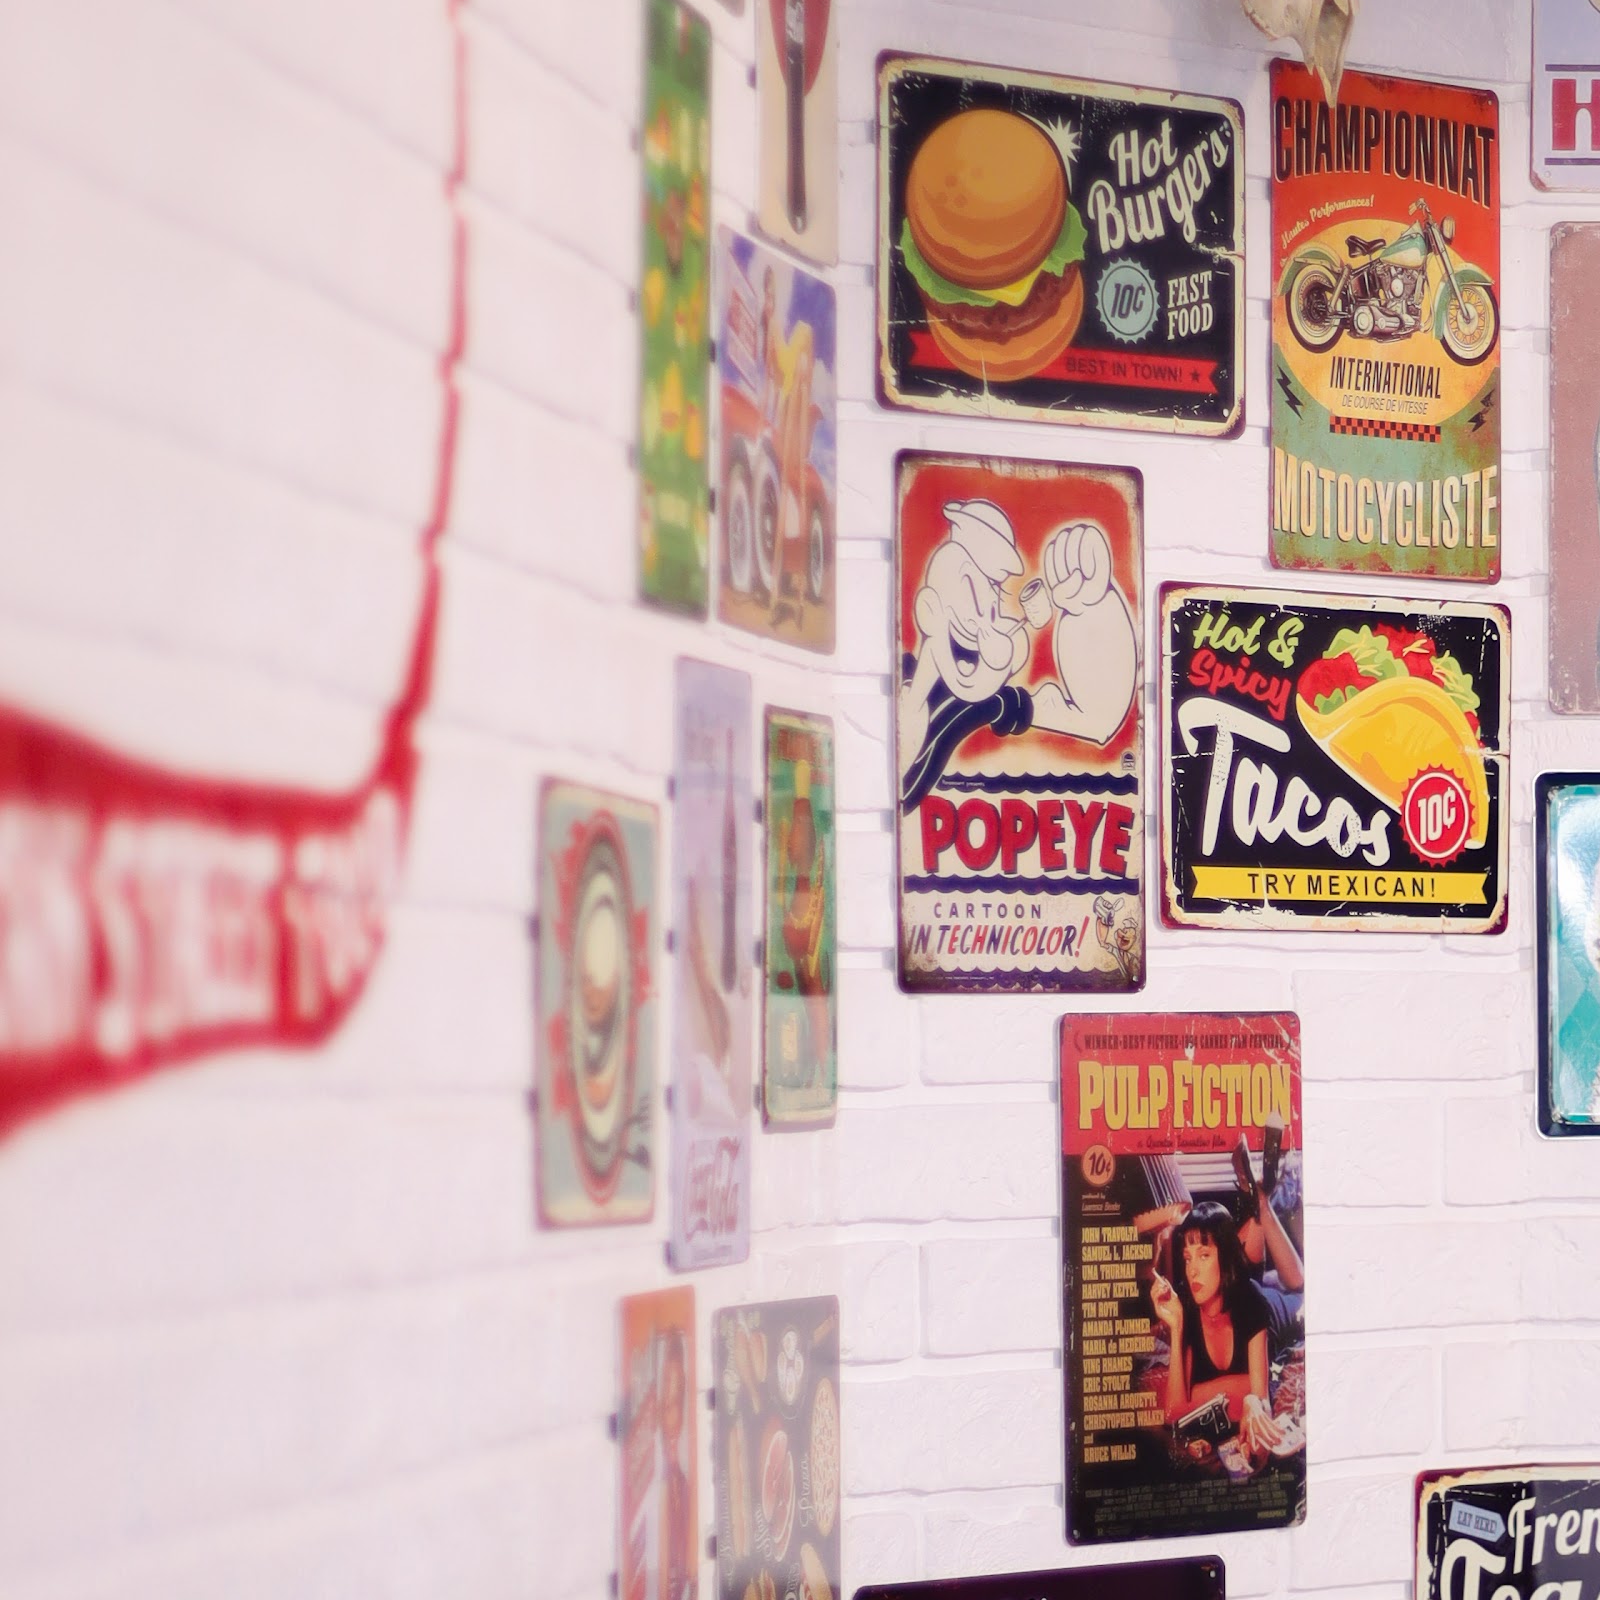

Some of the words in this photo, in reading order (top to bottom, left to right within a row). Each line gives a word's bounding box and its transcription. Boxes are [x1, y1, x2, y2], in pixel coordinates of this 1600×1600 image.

[1108, 117, 1179, 188] Hot
[1273, 94, 1496, 209] CHAMPIONNAT
[1087, 129, 1230, 254] Burgers
[1281, 220, 1309, 249] Hautes
[1167, 270, 1213, 309] FAST
[1167, 304, 1214, 341] FOOD
[1065, 356, 1106, 375] BEST
[1111, 361, 1128, 377] IN
[1132, 363, 1183, 381] TOWN!
[1329, 355, 1441, 400] INTERNATIONAL
[1342, 394, 1352, 407] DE
[1353, 395, 1384, 410] COURSE
[1385, 398, 1396, 412] DE
[1398, 399, 1429, 415] VITESSE
[1272, 446, 1498, 549] MOTOCYCLISTE
[1192, 611, 1266, 655] Hot
[1267, 616, 1305, 669] &
[1188, 649, 1292, 721] Spicy
[1177, 696, 1392, 867] Tacos
[920, 795, 1135, 878] POPEYE
[1247, 873, 1297, 895] TRY
[1307, 873, 1436, 898] MEXICAN!
[933, 902, 1042, 920] CARTOON
[909, 924, 932, 954] IN
[937, 917, 1090, 959] TECHNICOLOR!
[1078, 1060, 1170, 1131] PULP
[1172, 1060, 1292, 1129] FICTION
[1082, 1227, 1100, 1243] JOHN
[1101, 1225, 1139, 1243] TRAVOLTA
[1082, 1245, 1112, 1262] SAMUEL
[1122, 1244, 1153, 1261] JACKSON
[1082, 1264, 1099, 1281] UMA
[1100, 1263, 1136, 1280] THURMAN
[1082, 1282, 1111, 1300] HARVEY
[1112, 1281, 1140, 1298] KEITEL
[1082, 1302, 1097, 1318] TIM
[1098, 1301, 1119, 1318] ROTH
[1082, 1320, 1113, 1337] AMANDA
[1115, 1318, 1151, 1335] PLUMMER
[1083, 1339, 1107, 1356] MARIA
[1108, 1339, 1117, 1354] de
[1118, 1336, 1156, 1353] MEDEIROS
[1083, 1358, 1100, 1374] VING
[1083, 1377, 1100, 1393] ERIC
[1102, 1375, 1131, 1392] STOLTZ
[1083, 1394, 1119, 1412] ROSANNA
[1120, 1392, 1157, 1410] ARQUETTE
[1084, 1412, 1135, 1431] CHRISTOPHER
[1084, 1446, 1109, 1463] BRUCE
[1110, 1444, 1136, 1461] WILLIS
[1457, 1510, 1472, 1527] EAT
